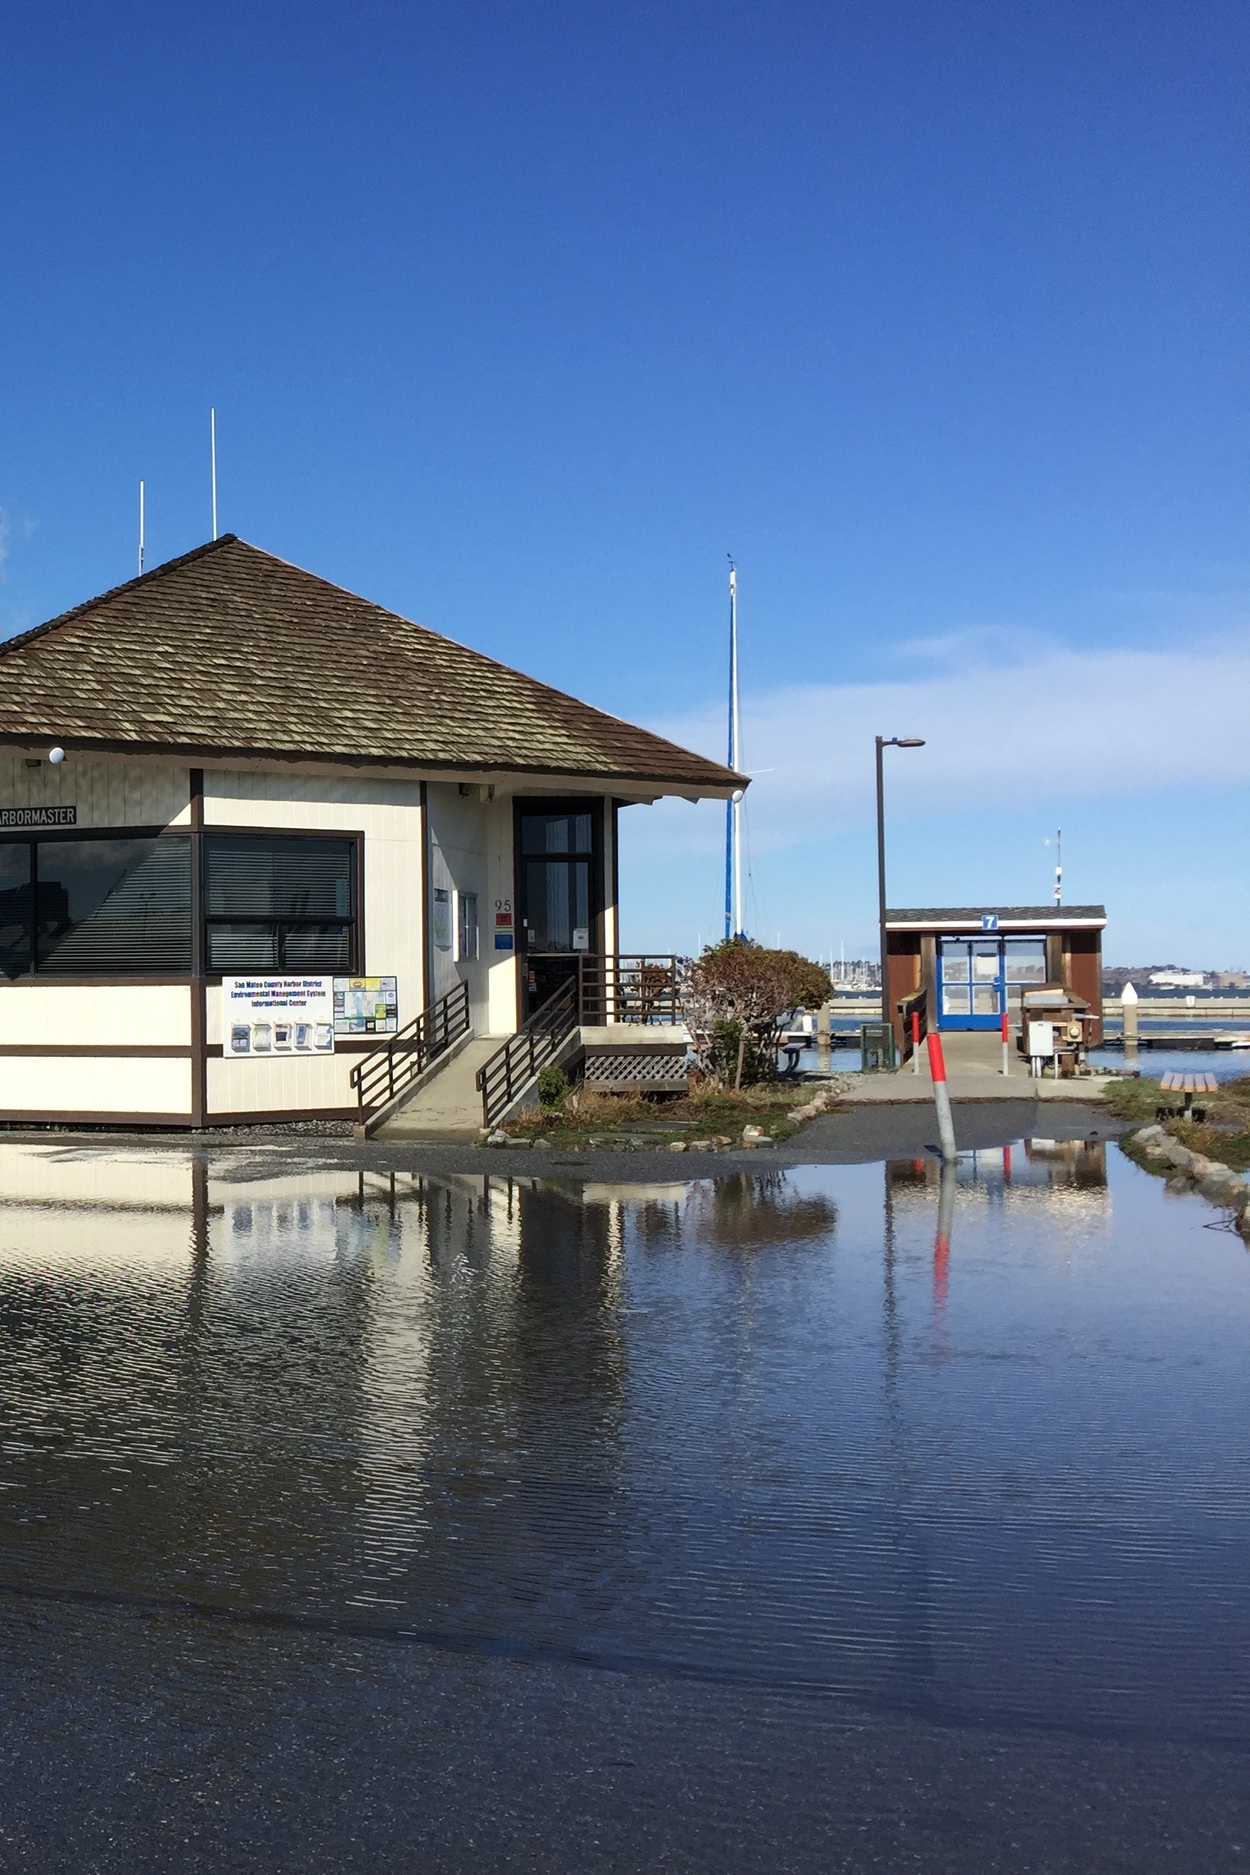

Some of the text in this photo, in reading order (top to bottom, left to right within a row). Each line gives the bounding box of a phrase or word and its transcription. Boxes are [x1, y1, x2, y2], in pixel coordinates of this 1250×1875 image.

[495, 899, 512, 912] 95
[985, 916, 995, 929] 7
[264, 980, 283, 988] County
[283, 980, 301, 988] Harbor
[302, 980, 322, 988] District
[230, 990, 270, 998] Environmental
[271, 990, 306, 998] Management
